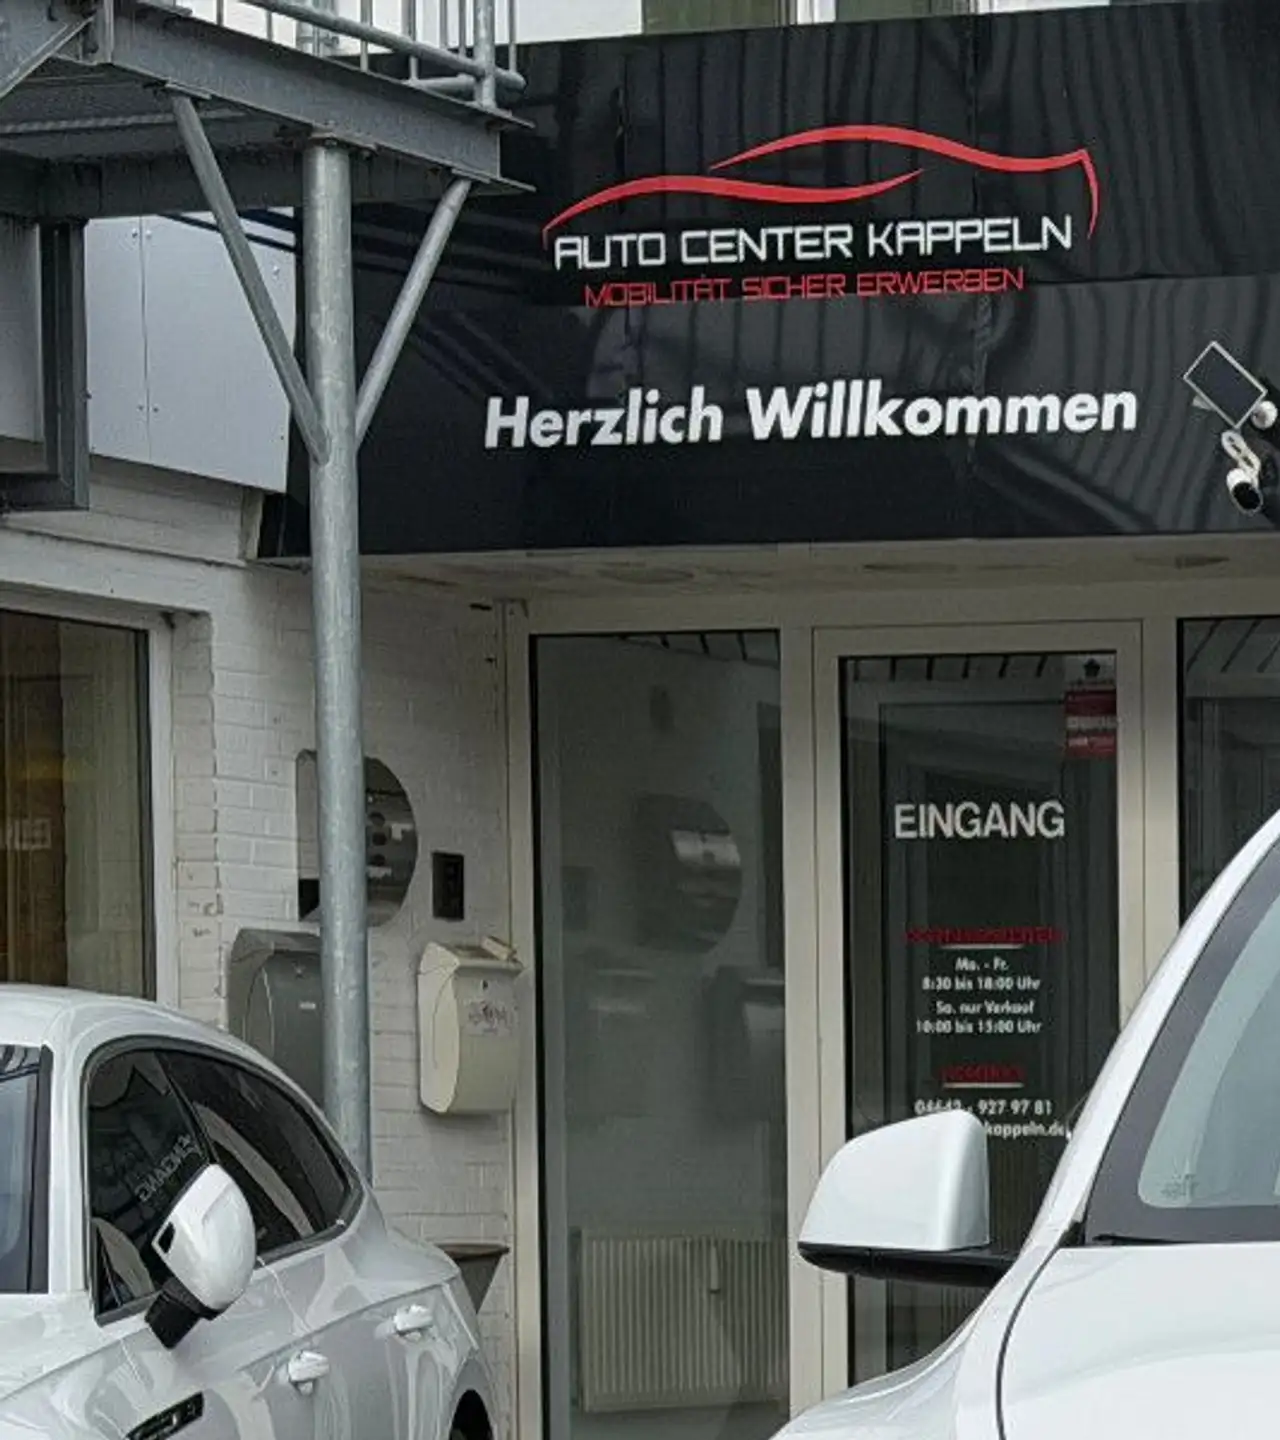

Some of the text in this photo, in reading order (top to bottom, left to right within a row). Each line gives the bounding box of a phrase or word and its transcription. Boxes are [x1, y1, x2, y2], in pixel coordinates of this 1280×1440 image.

[554, 215, 1072, 270] AUTO CENTER KAPPELN
[741, 273, 846, 300] SICHER
[856, 266, 1024, 298] ERWERBEN
[485, 378, 1138, 448] Herzlich Willkommen
[894, 800, 1065, 839] EINGANG
[955, 975, 973, 990] bis
[1016, 975, 1041, 990] Uhr
[955, 1019, 974, 1034] bis
[1017, 1019, 1042, 1034] Uhr
[978, 1099, 1005, 1115] 927
[1010, 1099, 1031, 1115] 97
